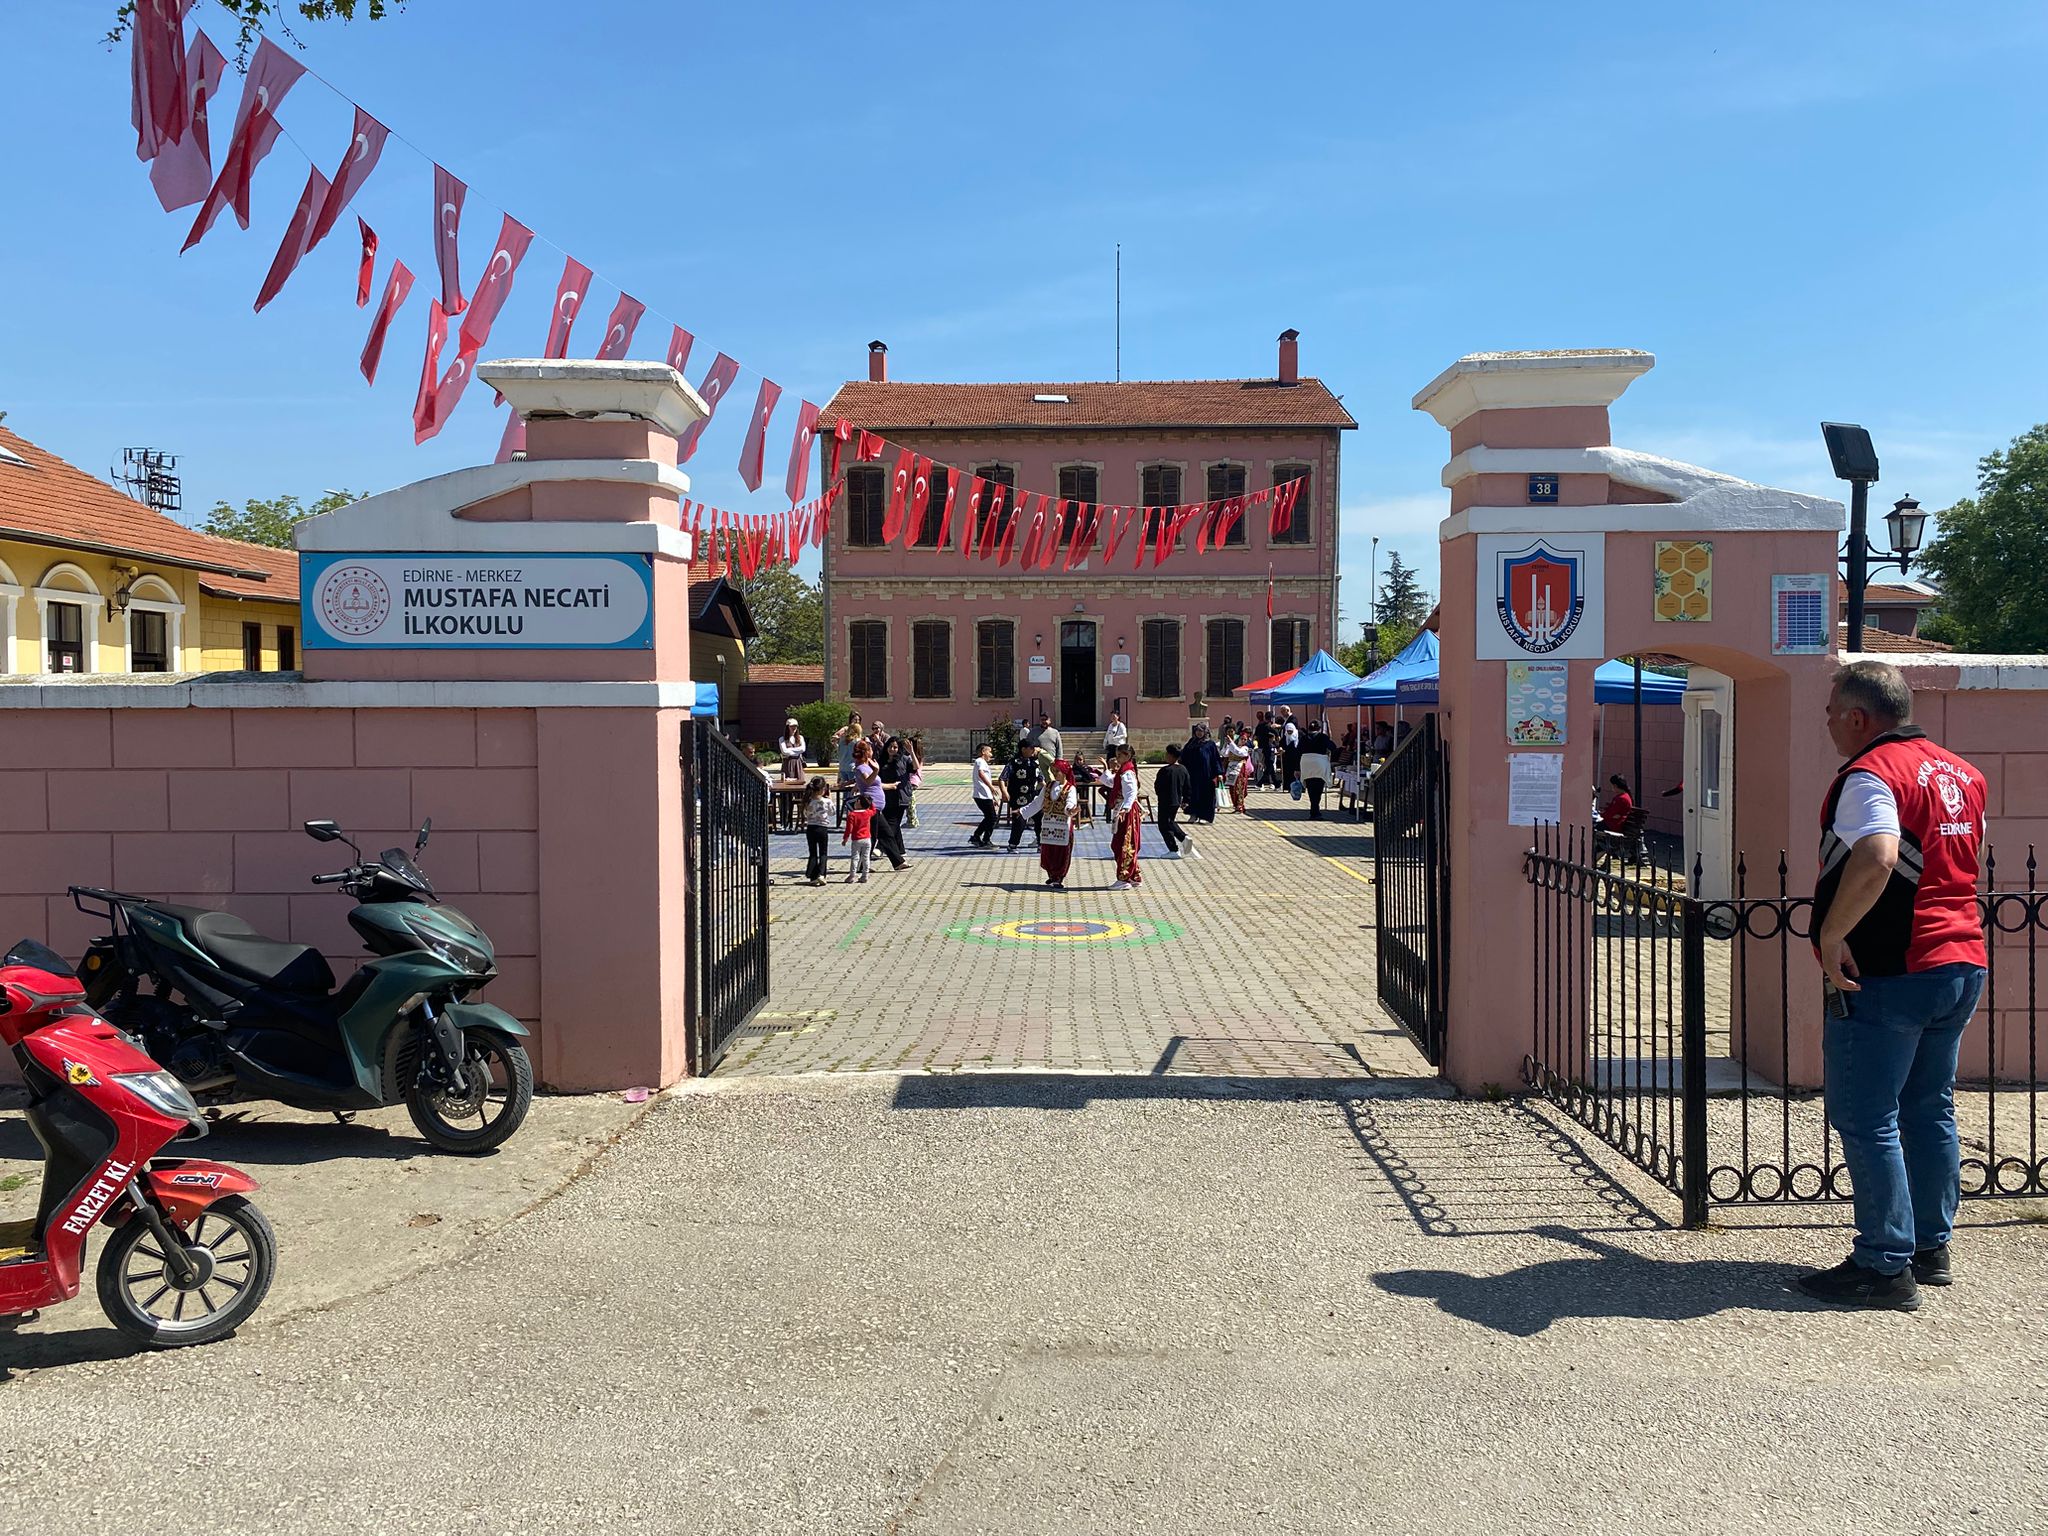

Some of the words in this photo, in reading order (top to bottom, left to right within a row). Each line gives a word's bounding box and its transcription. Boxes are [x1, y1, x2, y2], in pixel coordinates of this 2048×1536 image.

[1536, 483, 1551, 495] 38
[403, 567, 453, 582] EDİRNE
[465, 569, 522, 582] MERKEZ
[404, 588, 518, 608] MUSTAFA
[524, 584, 610, 608] NECATİ
[404, 611, 524, 635] İLKOKULU
[1499, 607, 1523, 645] MUSTAFA
[61, 1178, 116, 1235] FARZET
